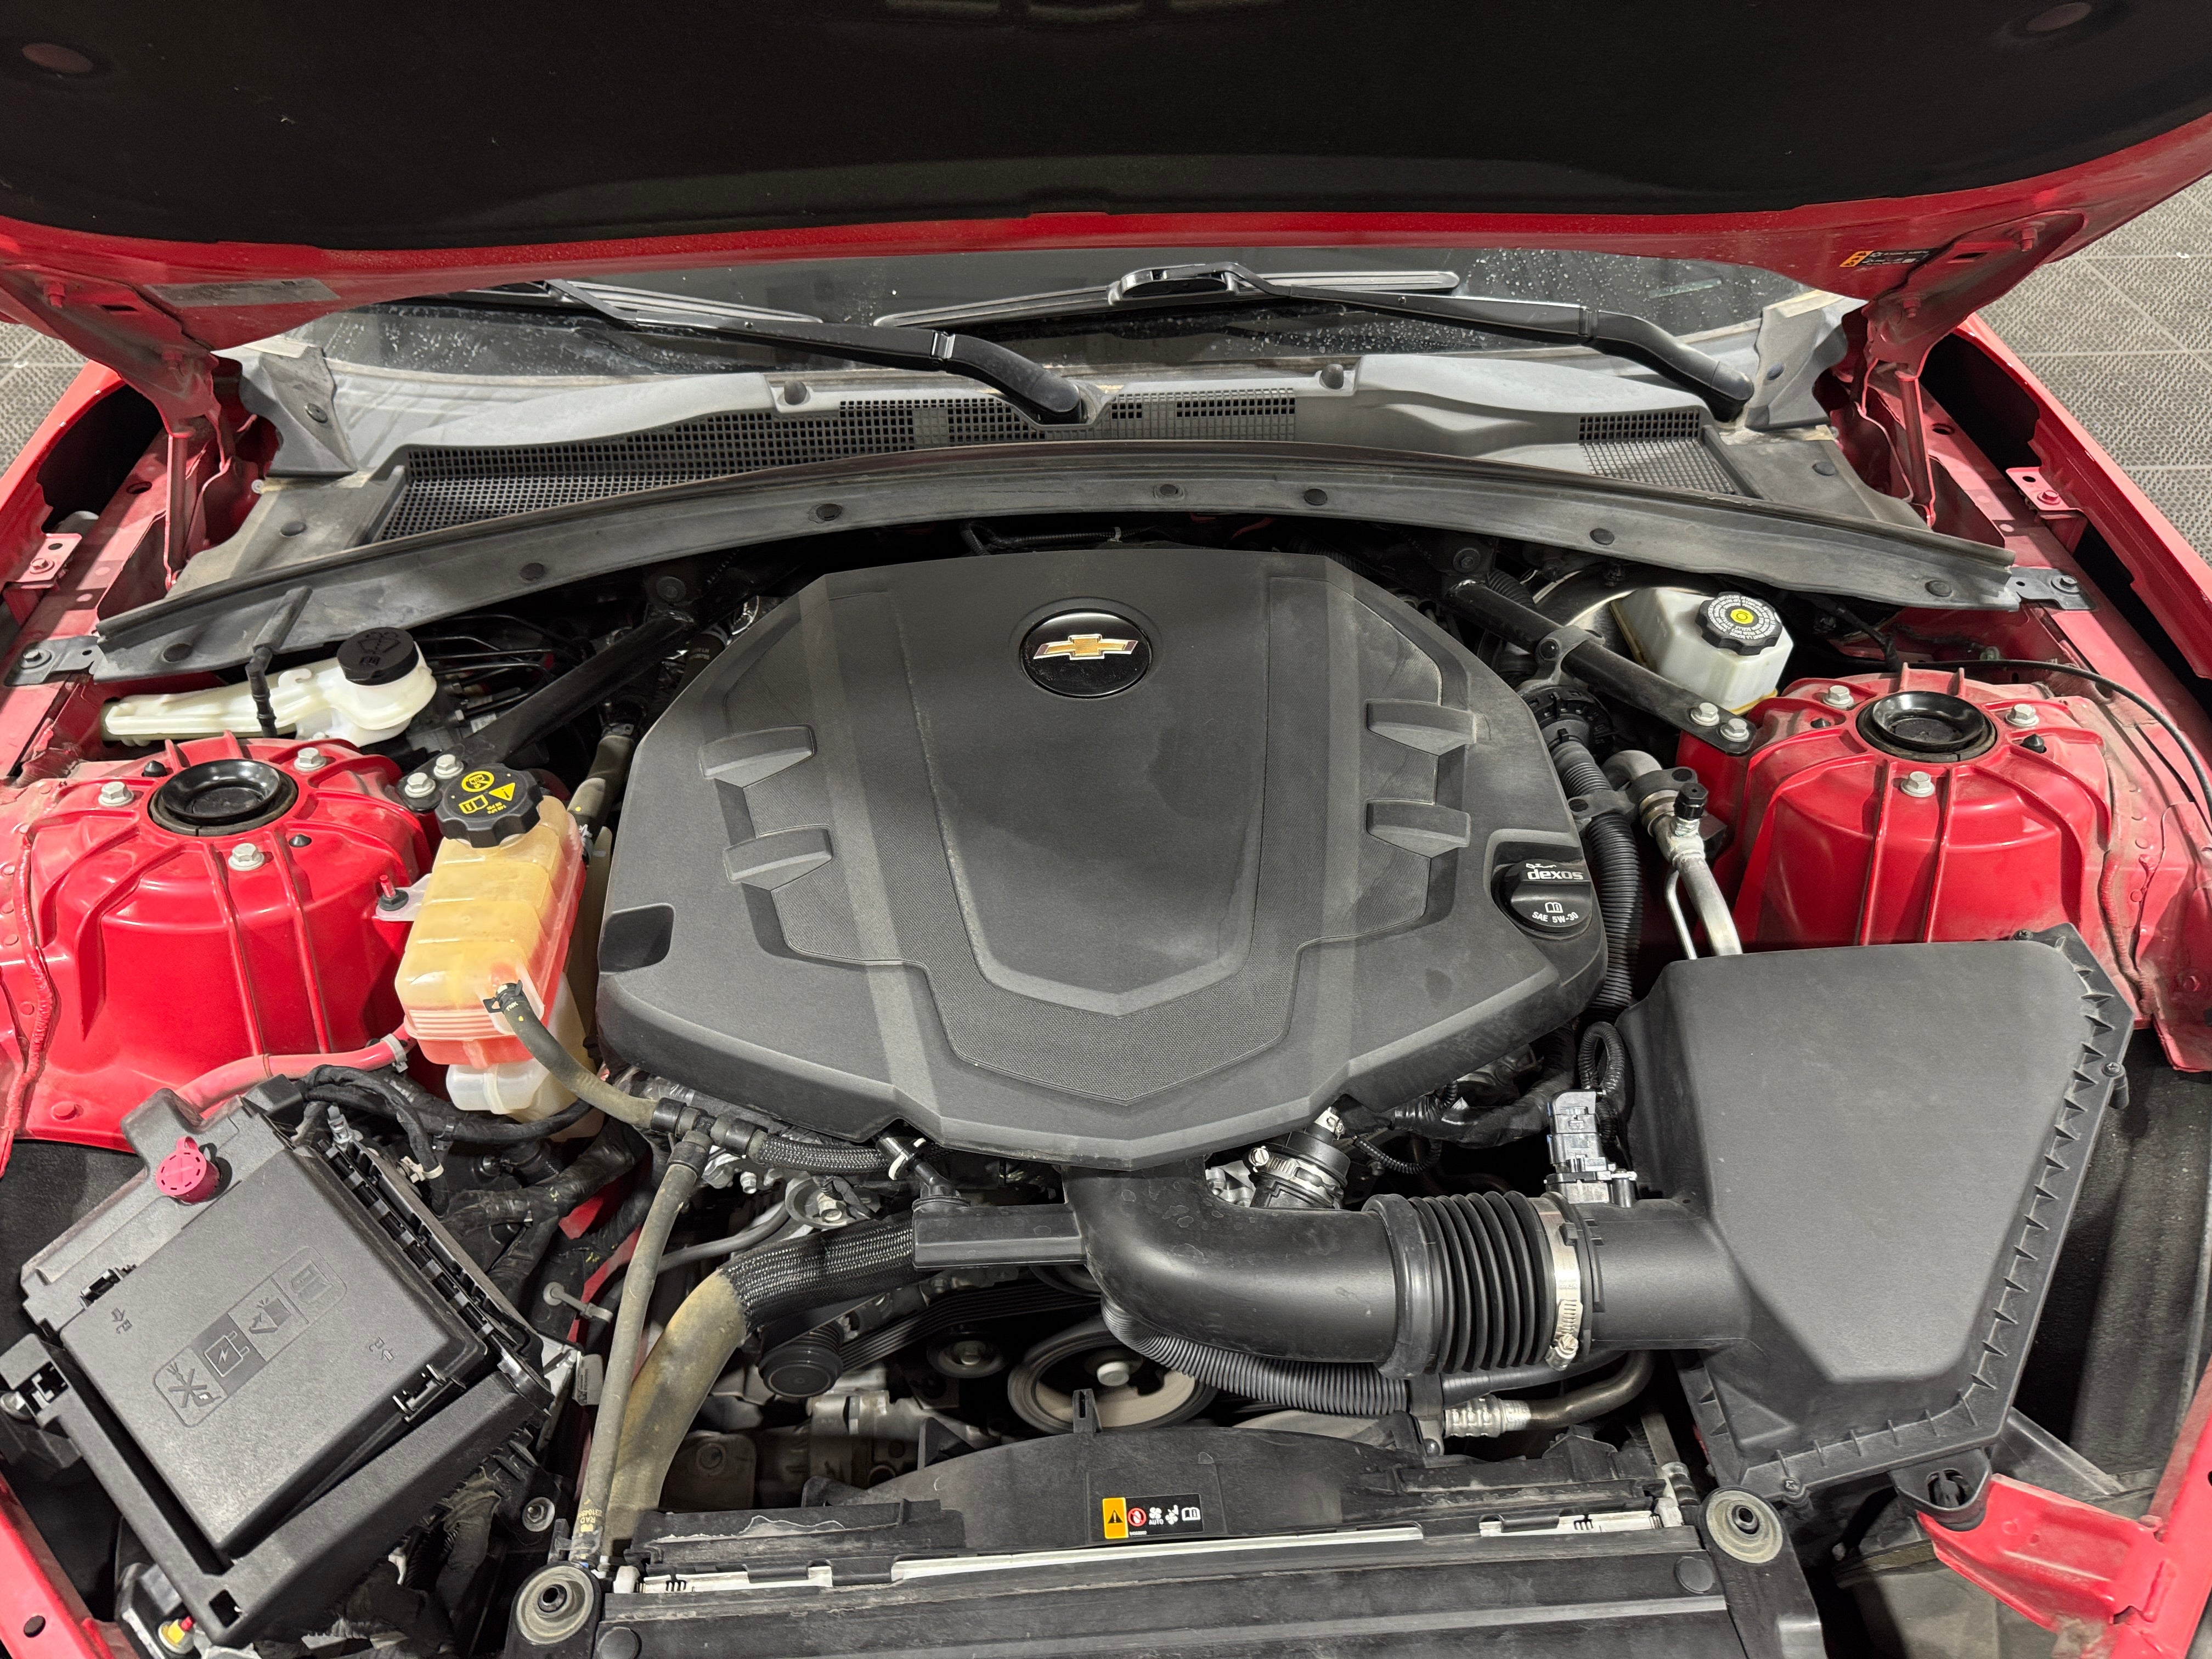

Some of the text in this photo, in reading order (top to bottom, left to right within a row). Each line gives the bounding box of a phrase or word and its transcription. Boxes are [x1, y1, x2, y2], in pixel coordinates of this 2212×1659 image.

[1527, 869, 1583, 880] dexos
[1532, 911, 1579, 923] SAE 5W-30
[580, 1516, 596, 1524] RAD
